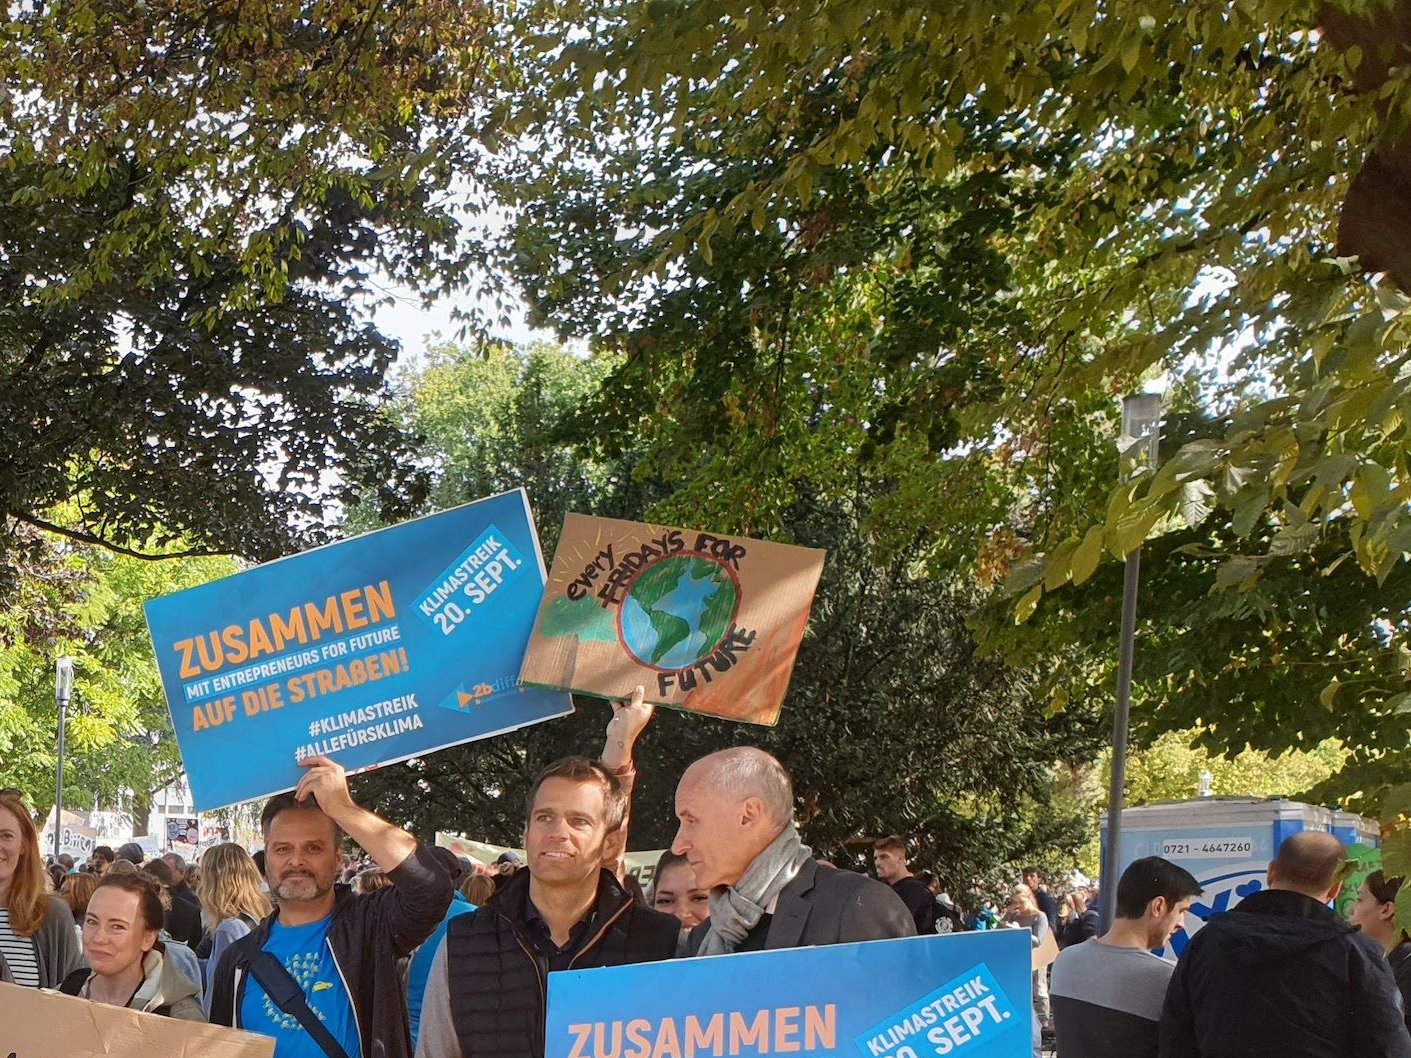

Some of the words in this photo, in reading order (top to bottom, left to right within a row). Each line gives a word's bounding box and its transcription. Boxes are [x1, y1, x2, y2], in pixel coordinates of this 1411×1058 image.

[417, 534, 502, 617] KLIMASTREIK
[566, 544, 616, 602] every
[693, 533, 746, 571] FOR
[432, 606, 471, 637] 20.
[462, 546, 523, 604] SEPT.
[173, 580, 396, 679] ZUSAMMEN
[186, 680, 210, 700] MIT
[213, 651, 320, 692] ENTREPRENEURS
[321, 642, 347, 660] FOR
[349, 626, 401, 653] FUTURE
[473, 675, 517, 700] 2bdiff
[657, 623, 757, 698] FUTURE
[192, 698, 237, 732] AUF
[244, 687, 284, 716] DIE
[295, 714, 424, 763] #ALLEFÜRSKLIMA
[308, 693, 419, 738] #KLIMASTREIK
[1163, 844, 1190, 854] 0721
[1202, 842, 1251, 853] 4647260
[866, 975, 991, 1058] KLIMASTREIK
[926, 994, 1012, 1057] SEPT.
